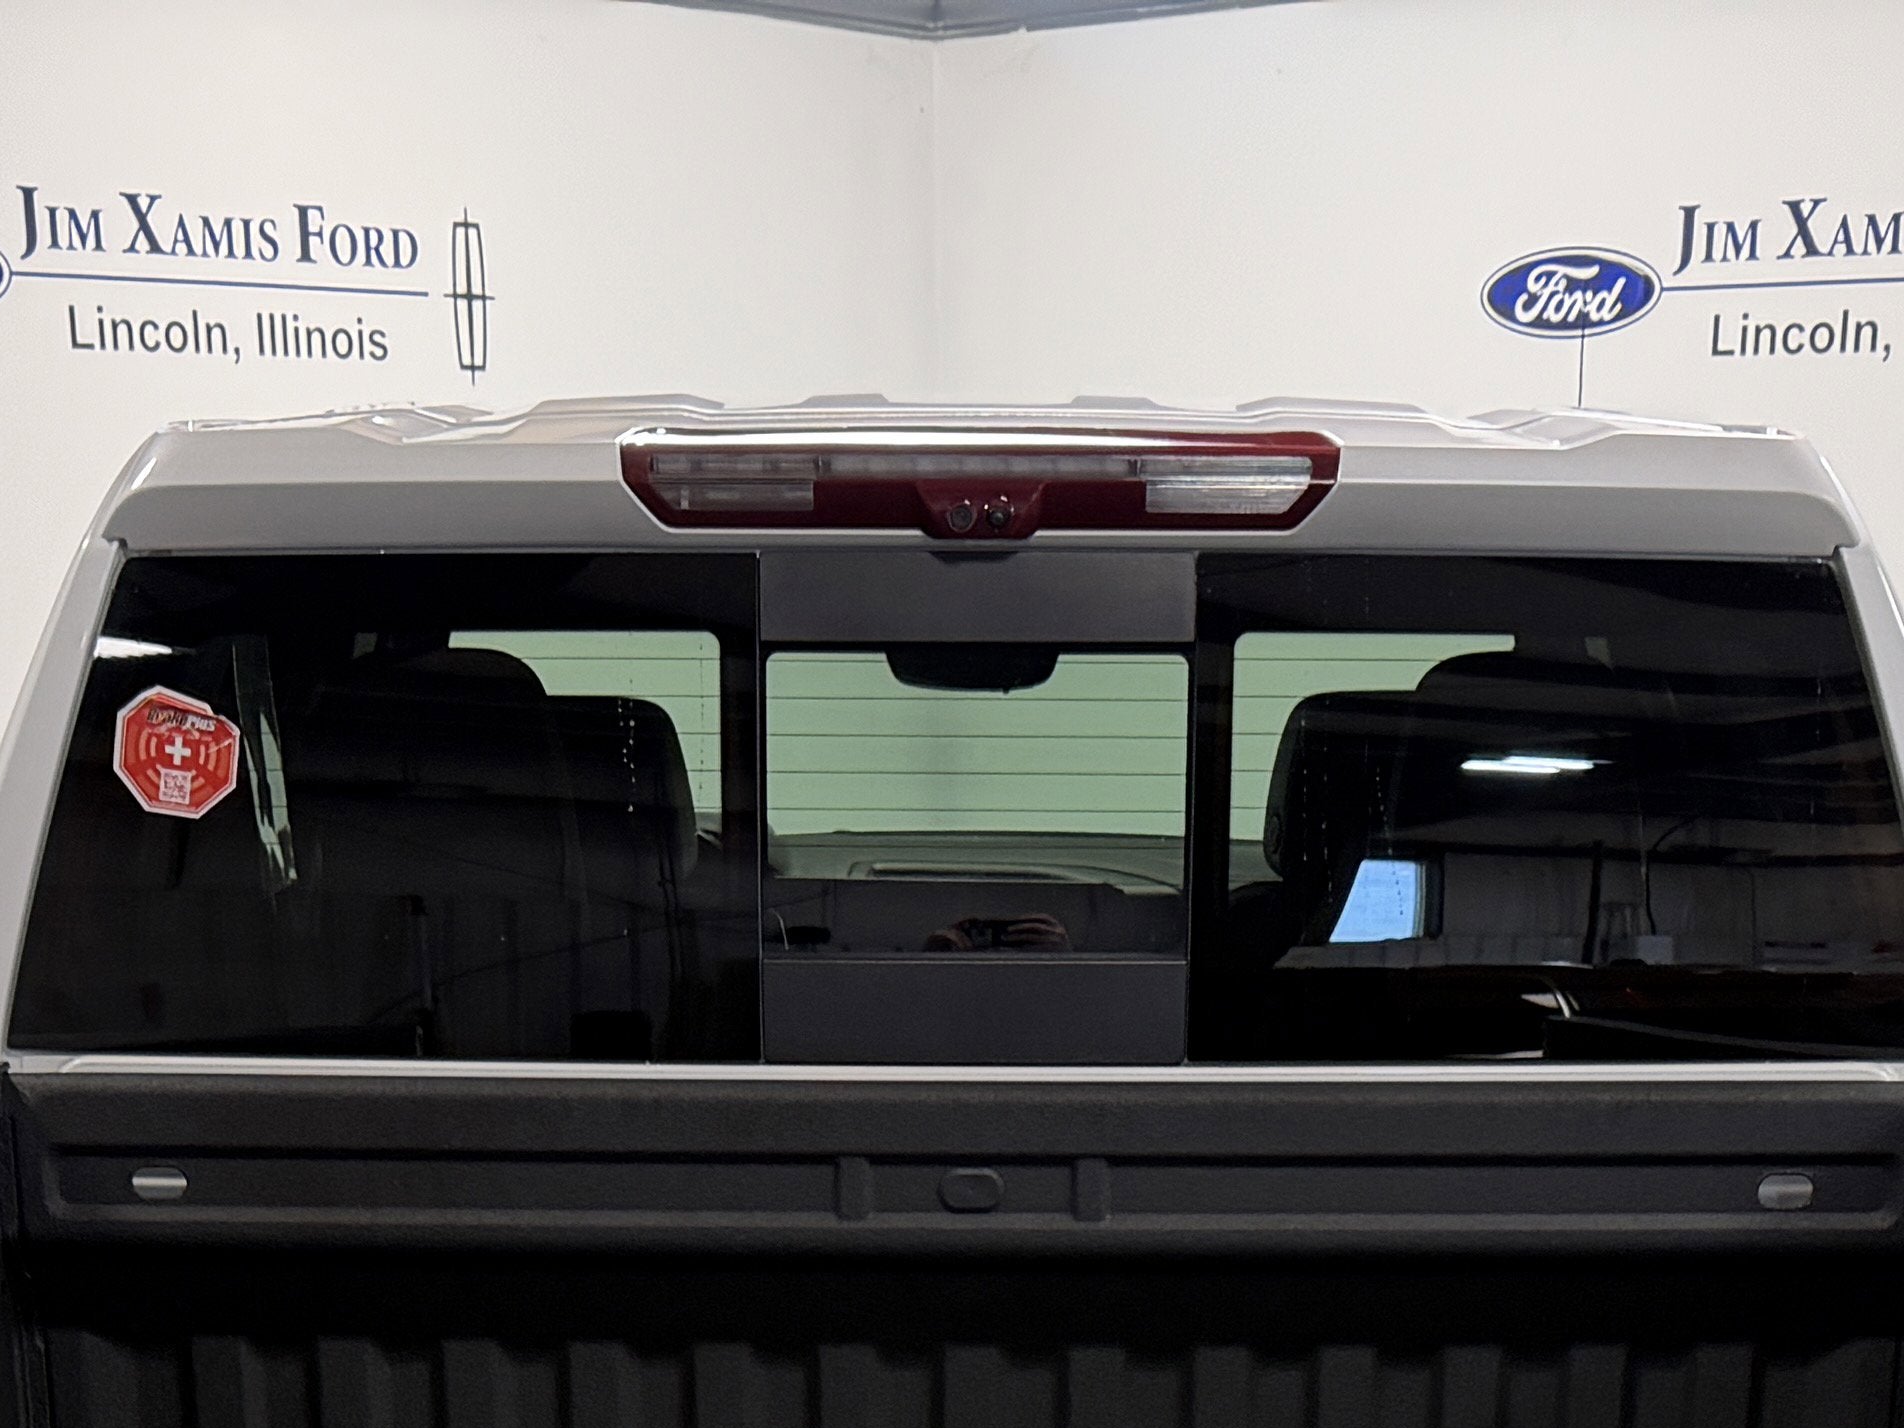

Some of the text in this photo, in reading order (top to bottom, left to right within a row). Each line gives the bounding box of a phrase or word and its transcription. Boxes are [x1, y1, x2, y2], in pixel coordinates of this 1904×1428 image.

[16, 185, 419, 269] JIM XAMIS FORD
[1672, 204, 1761, 276] JIM
[1514, 264, 1627, 323] Ford
[69, 305, 389, 364] Lincoln, Illinois
[1711, 308, 1892, 362] Lincoln,
